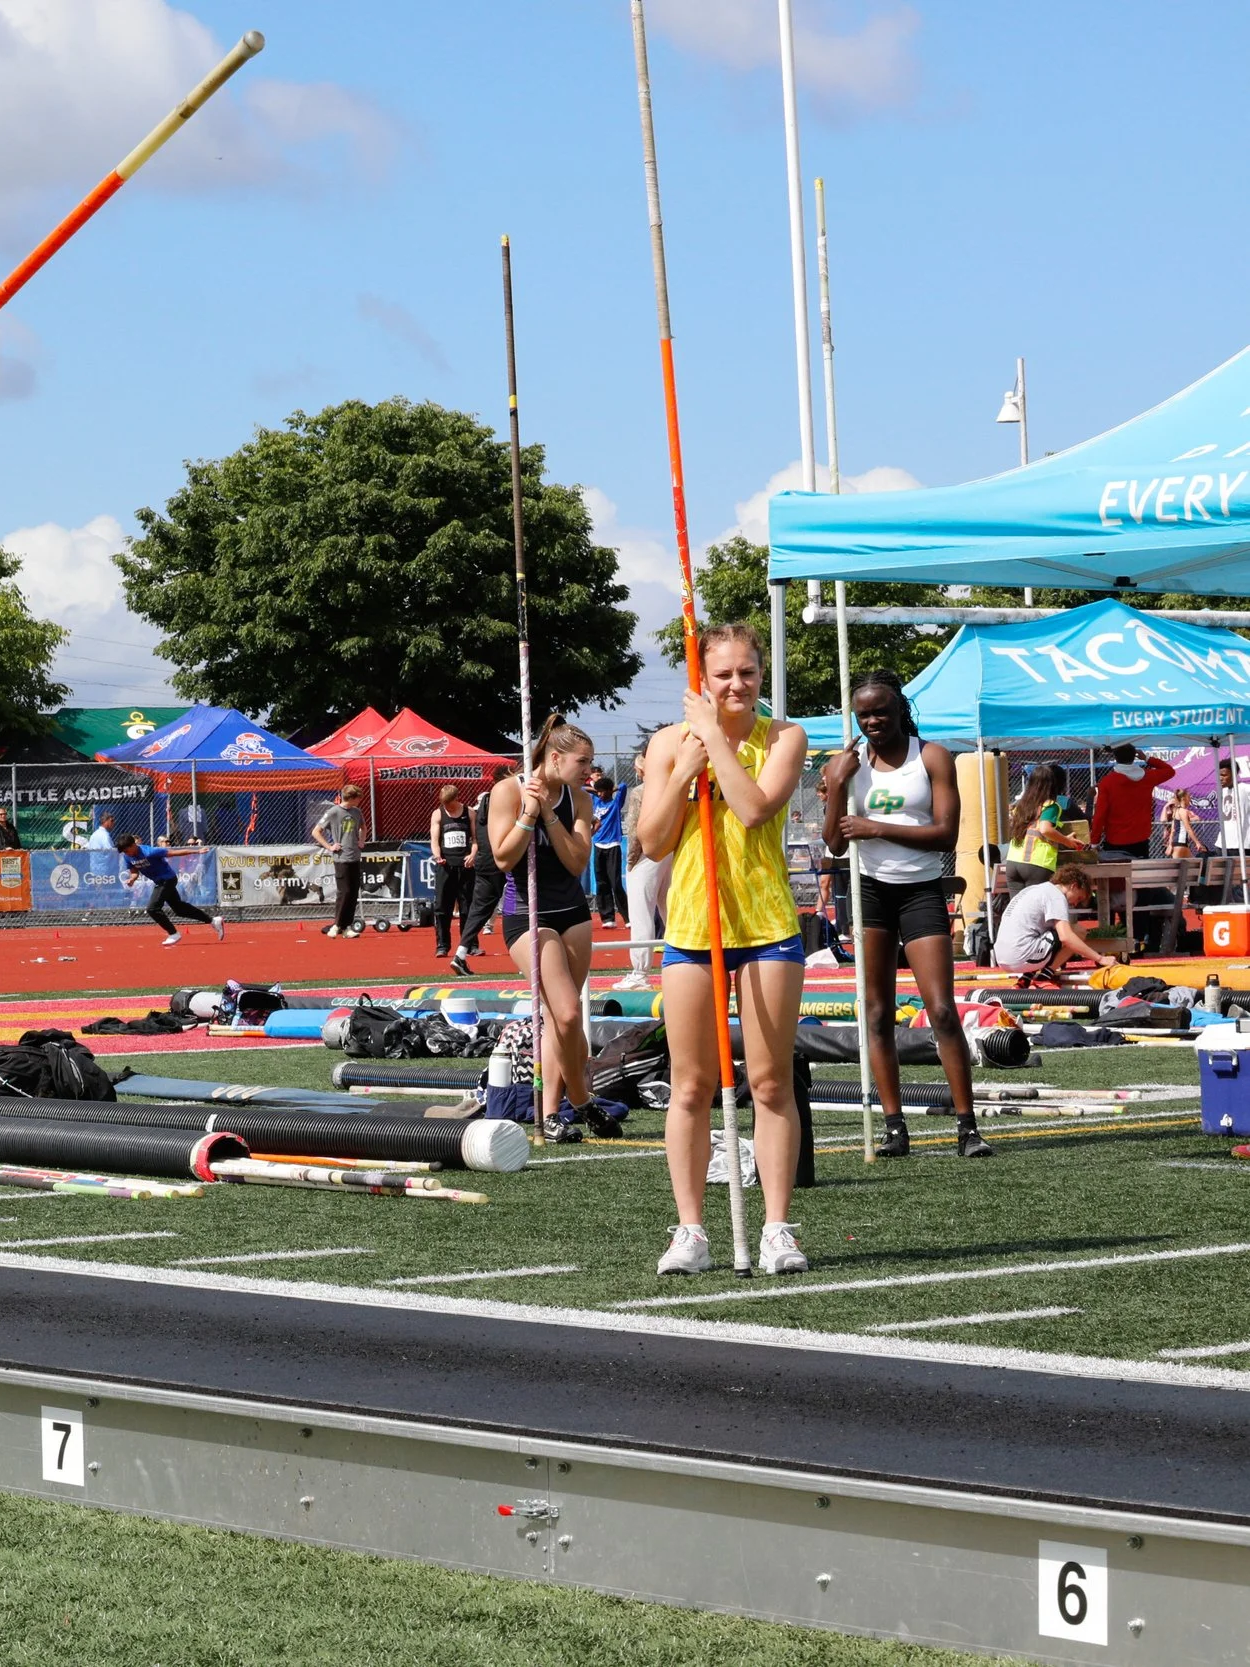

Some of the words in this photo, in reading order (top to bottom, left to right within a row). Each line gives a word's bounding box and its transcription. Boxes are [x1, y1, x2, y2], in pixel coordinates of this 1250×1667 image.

[1098, 471, 1249, 527] EVERY
[1054, 680, 1178, 701] PUBLIC
[1112, 711, 1165, 728] EVERY
[1170, 708, 1249, 726] STUDENT.
[378, 764, 483, 780] BLACKHAWKS
[63, 784, 149, 801] ACADEMY
[219, 855, 255, 868] YOUR
[258, 854, 310, 867] FUTURE
[83, 872, 116, 885] Gesa
[1213, 920, 1230, 947] G
[52, 1423, 72, 1470] 7
[1057, 1561, 1088, 1626] 6
